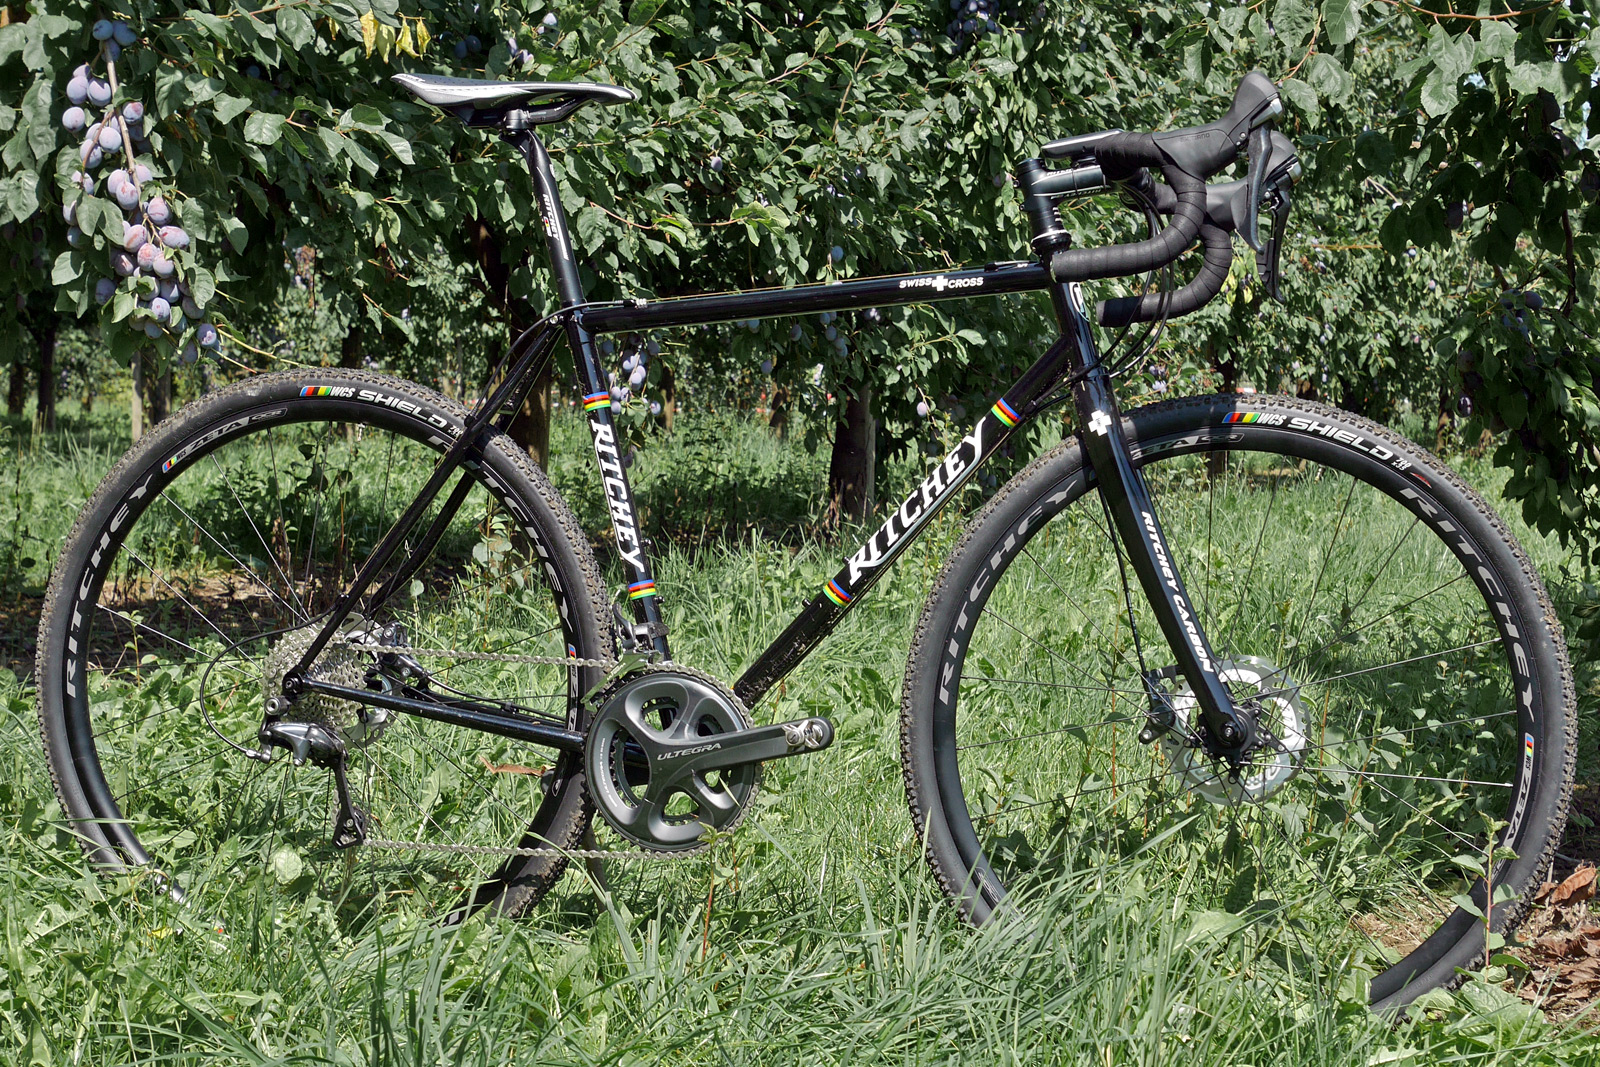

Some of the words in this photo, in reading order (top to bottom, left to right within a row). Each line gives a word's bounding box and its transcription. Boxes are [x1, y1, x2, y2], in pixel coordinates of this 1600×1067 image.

[542, 193, 560, 241] RITCHEY
[899, 277, 932, 289] SWISS
[947, 277, 984, 289] CROSS
[330, 386, 356, 398] WCS
[357, 389, 448, 429] SHIELD
[1256, 412, 1287, 426] WCS
[1287, 416, 1394, 461] SHIELD
[1396, 457, 1412, 468] 700
[590, 418, 645, 573] RITCHEY
[849, 416, 987, 586] RITCHEY
[66, 473, 153, 699] RITCHEY
[939, 479, 1078, 706] RITCHEY
[1141, 510, 1179, 592] RITCHEY
[1173, 594, 1214, 673] CARBON
[1400, 487, 1535, 722] RITCHEY
[657, 742, 722, 761] ULTEGRA
[1525, 755, 1533, 770] WCS
